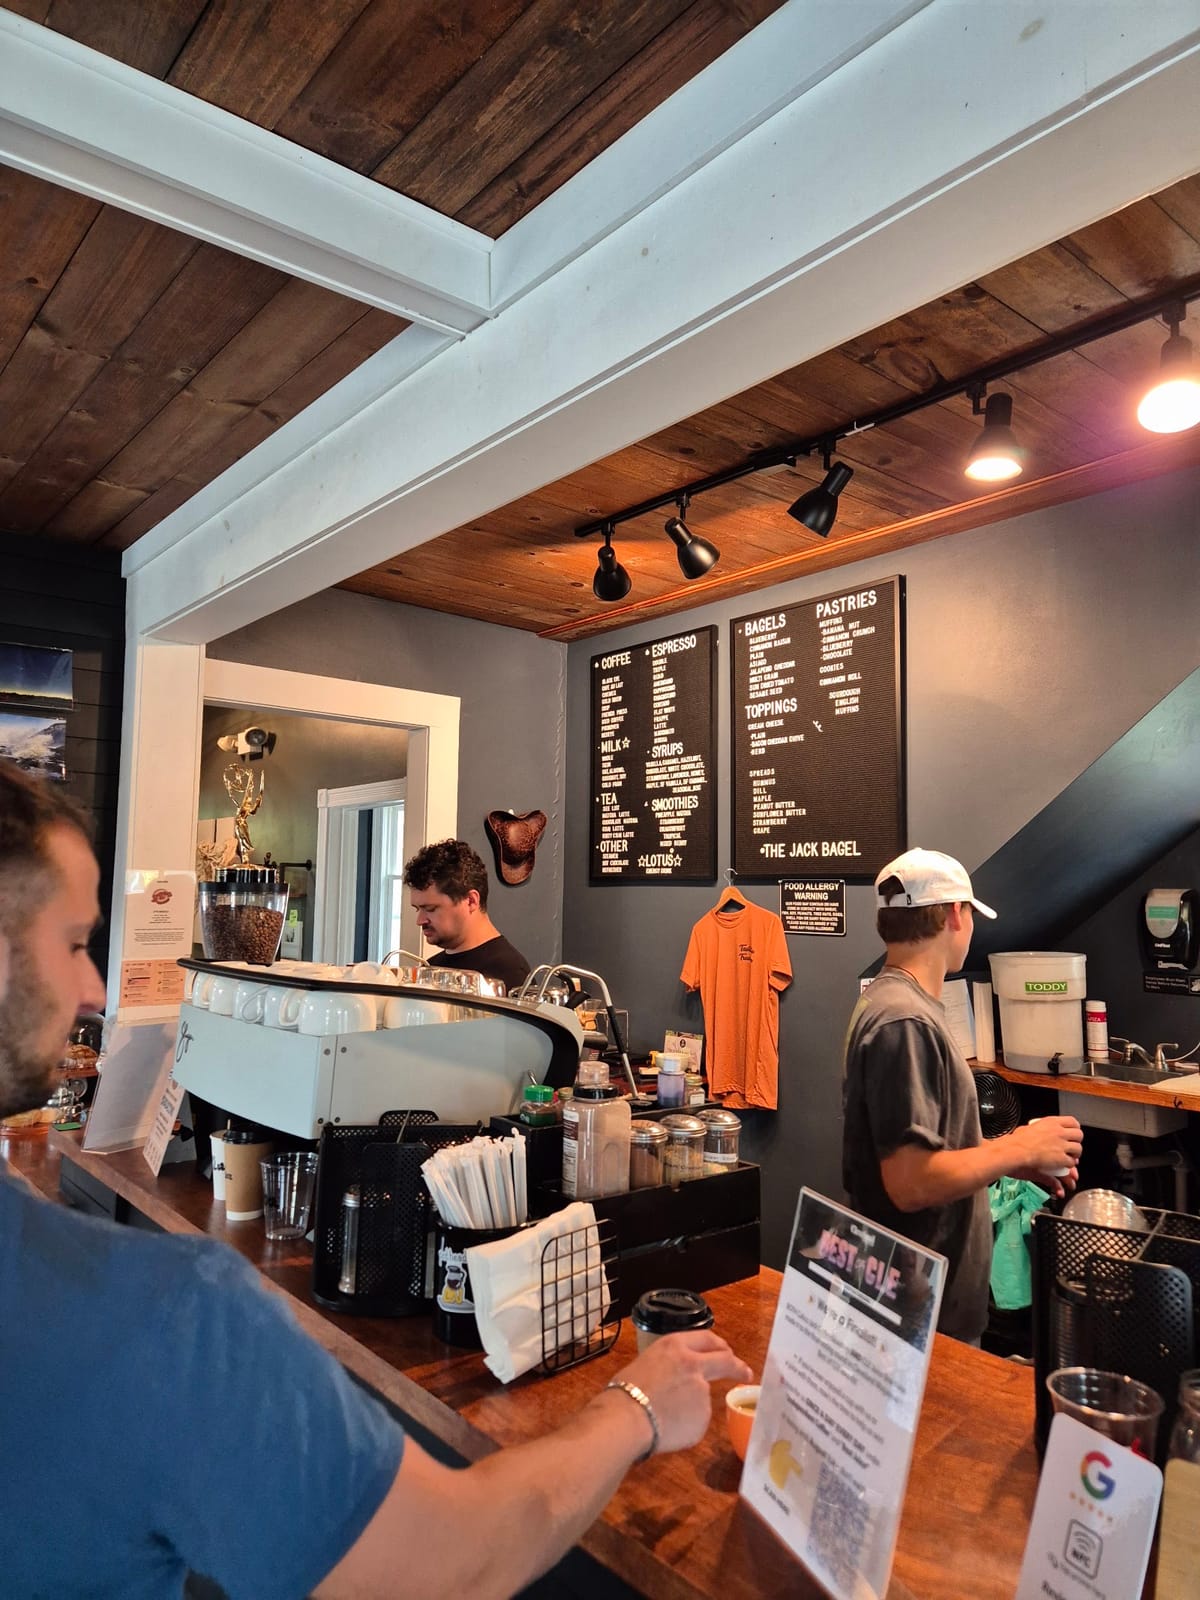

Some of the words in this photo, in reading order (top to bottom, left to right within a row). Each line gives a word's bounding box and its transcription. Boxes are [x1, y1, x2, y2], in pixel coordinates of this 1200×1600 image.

[816, 590, 877, 618] PASTRIES
[745, 613, 786, 636] BAGELS
[819, 616, 842, 628] MUFFINS
[849, 621, 860, 630] NUT
[852, 626, 875, 637] CRUNCH
[750, 632, 777, 644] BLUEBERRY
[652, 634, 696, 658] ESPRESSO
[750, 642, 772, 652] CINNAMON
[602, 651, 631, 669] COFFEE
[750, 651, 764, 660] PLAIN
[820, 648, 853, 660] -CHOCOLATE
[819, 663, 844, 673] COOKIES
[775, 676, 794, 686] TOMATO
[819, 675, 846, 686] CINNAMON
[848, 672, 862, 681] ROLL
[750, 690, 769, 699] SESAME
[769, 687, 783, 695] SEED
[829, 688, 860, 699] SOURDOUGH
[835, 696, 859, 707] ENGLISH
[745, 698, 797, 719] TOPPINGS
[835, 705, 859, 715] MUFFINS
[654, 722, 667, 730] LATTE
[748, 722, 765, 731] CREAM
[766, 719, 784, 728] CHEESE
[601, 739, 621, 754] MILK
[652, 742, 683, 758] SYRUPS
[749, 768, 775, 777] SPREADS
[753, 787, 767, 795] DILL
[600, 793, 617, 805] TEA
[652, 795, 699, 811] SMOOTHIES
[753, 802, 774, 810] PEANUT
[753, 809, 784, 818] SUNFLOWER
[785, 808, 807, 816] BUTTER
[753, 818, 787, 826] STRAWBERRY
[600, 839, 628, 853] OTHER
[763, 843, 786, 858] THE
[789, 842, 819, 857] JACK
[822, 841, 861, 857] BAGEL
[646, 854, 674, 867] LOTUS
[805, 883, 839, 891] ALLERGY
[794, 892, 828, 900] WARNING
[1027, 983, 1067, 991] TODDY
[864, 1256, 900, 1300] CLE
[1081, 1450, 1116, 1500] G
